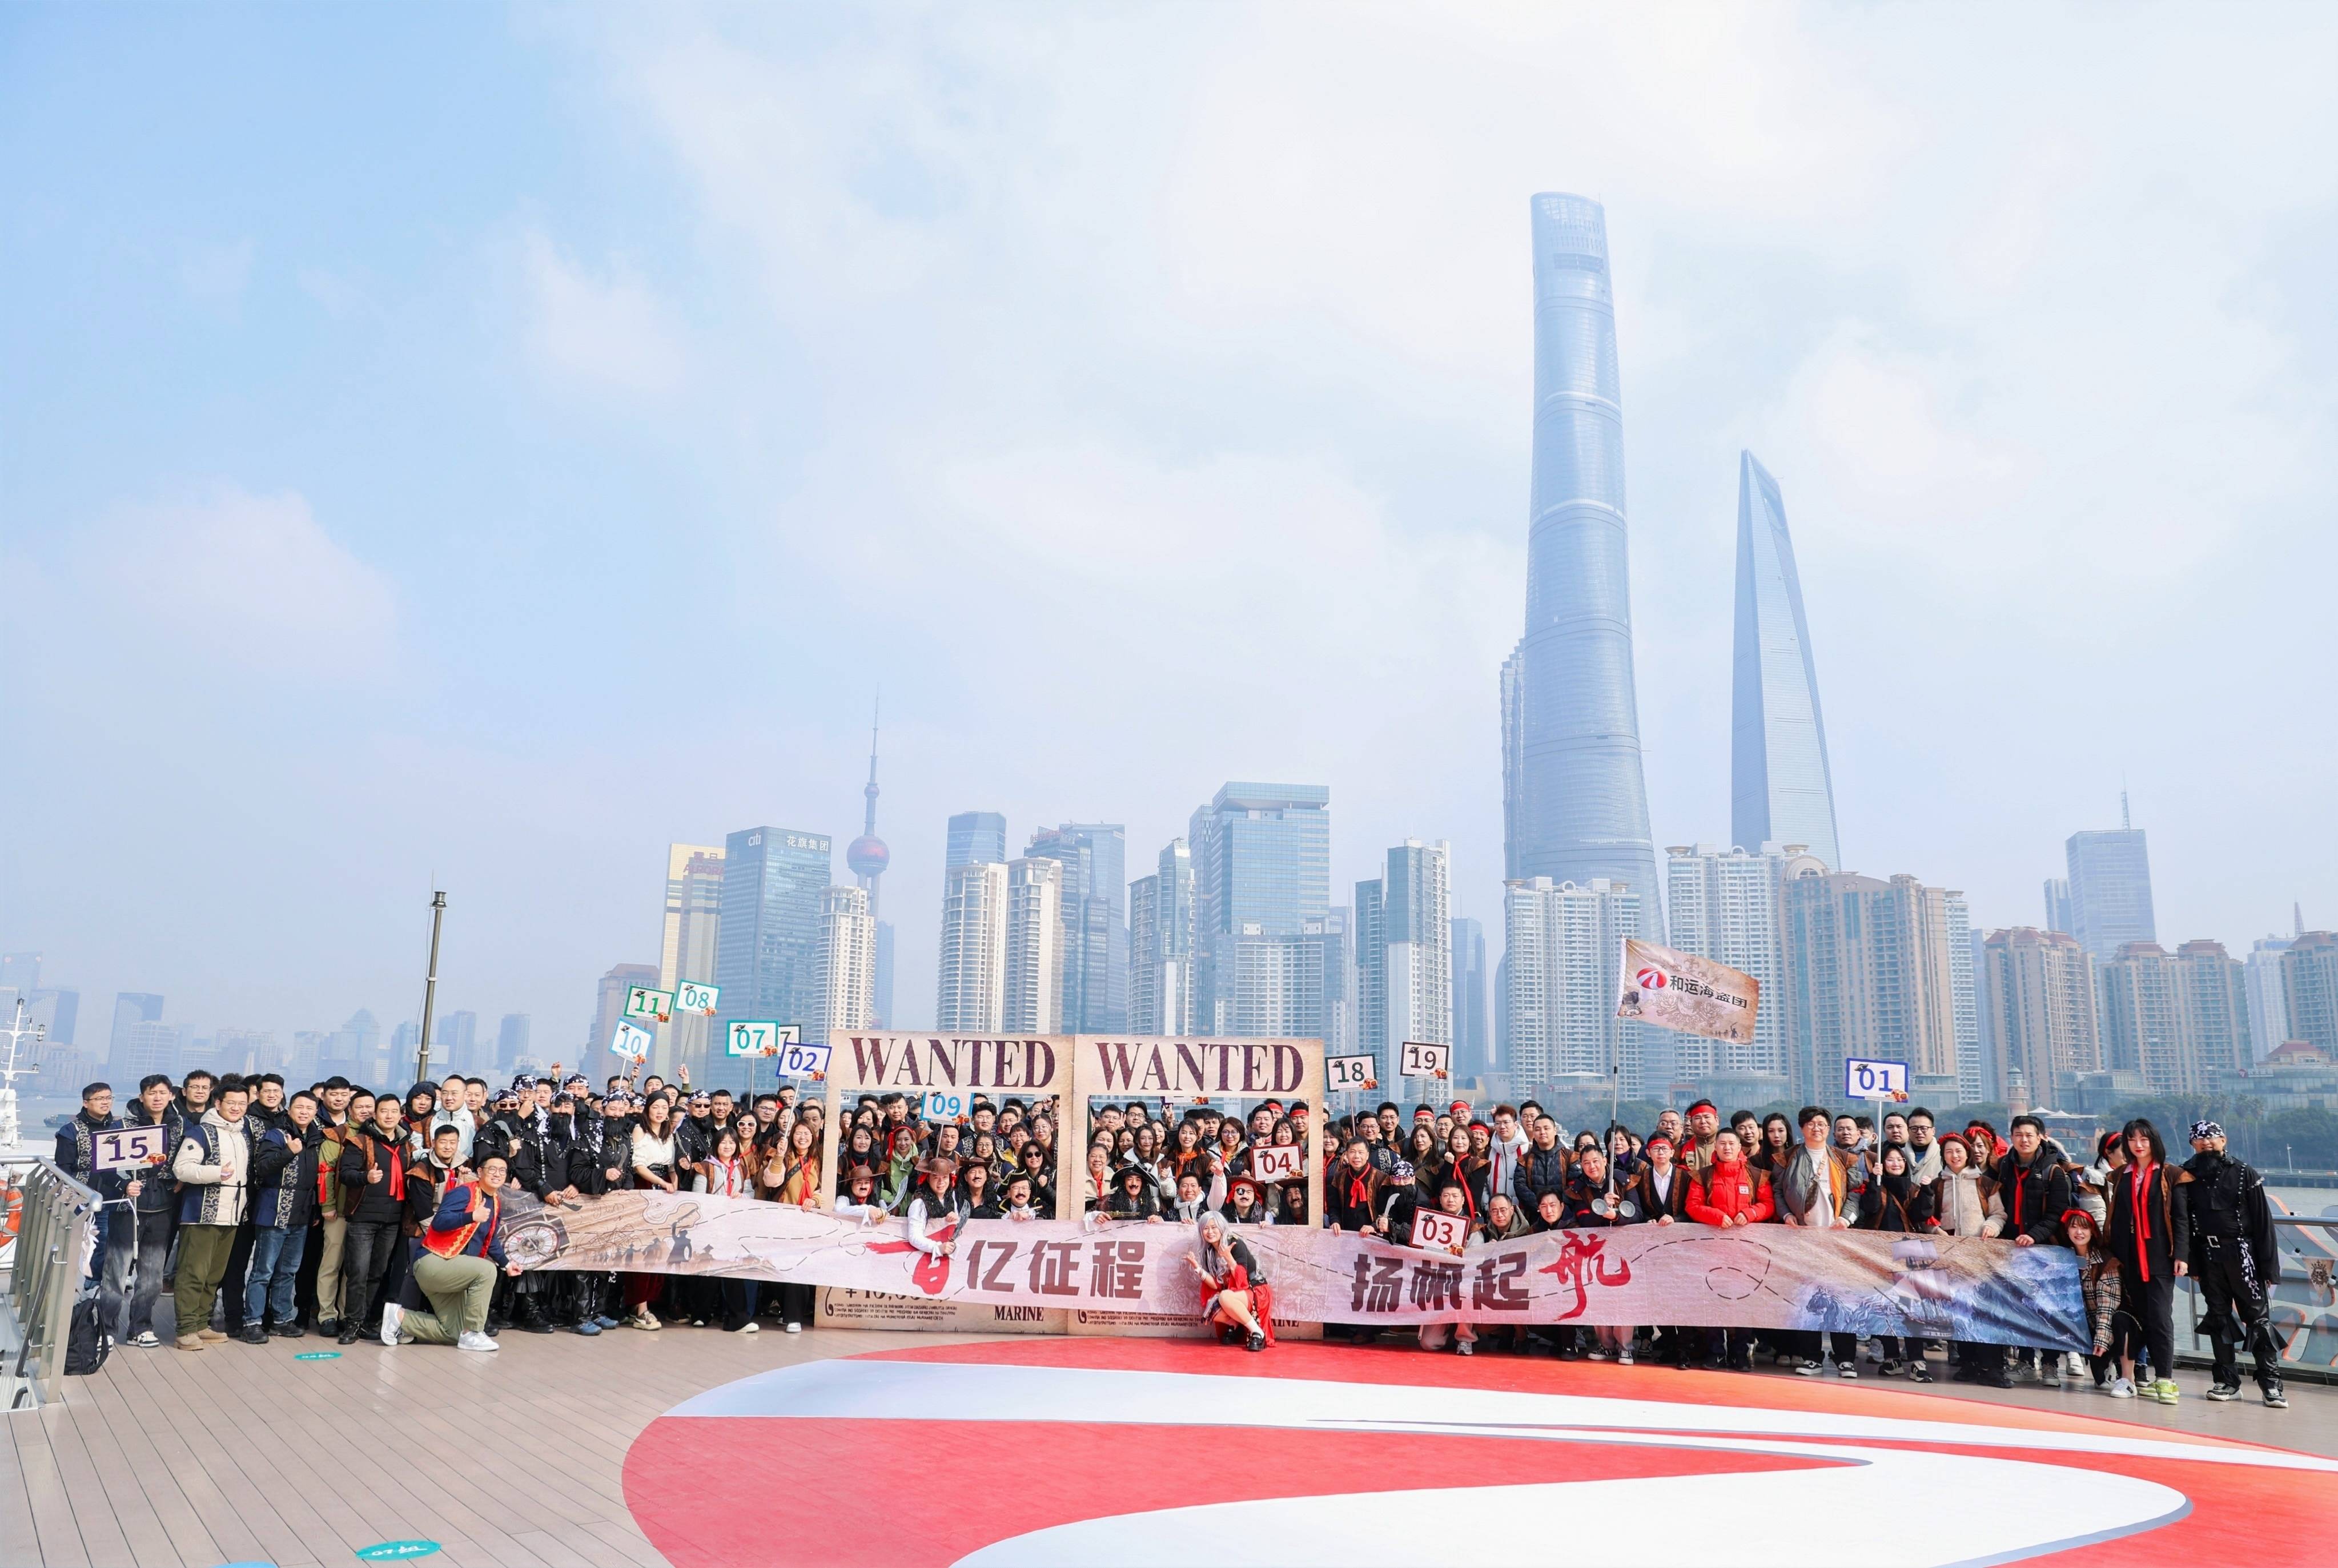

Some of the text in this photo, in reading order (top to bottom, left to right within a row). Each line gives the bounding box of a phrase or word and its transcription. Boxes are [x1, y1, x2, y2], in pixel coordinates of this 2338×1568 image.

[748, 833, 761, 846] citi
[786, 835, 829, 851] 花旗集团
[685, 988, 709, 1009] 08
[1669, 975, 1748, 1009] 和运海盗团
[635, 996, 659, 1015] 11
[619, 1032, 641, 1054] 10
[737, 1030, 766, 1050] 07
[789, 1050, 817, 1072] 02
[850, 1038, 1055, 1088] WANTED
[1096, 1042, 1303, 1092] WANTED
[1410, 1050, 1437, 1070] 19
[1337, 1062, 1365, 1083] 18
[1859, 1069, 1893, 1092] 01
[932, 1095, 961, 1116] 09
[108, 1136, 148, 1161] 15
[1263, 1152, 1292, 1174] 04
[1422, 1222, 1452, 1245] 03
[1351, 1230, 1631, 1321] 扬帆起航
[994, 1305, 1044, 1321] MARINE
